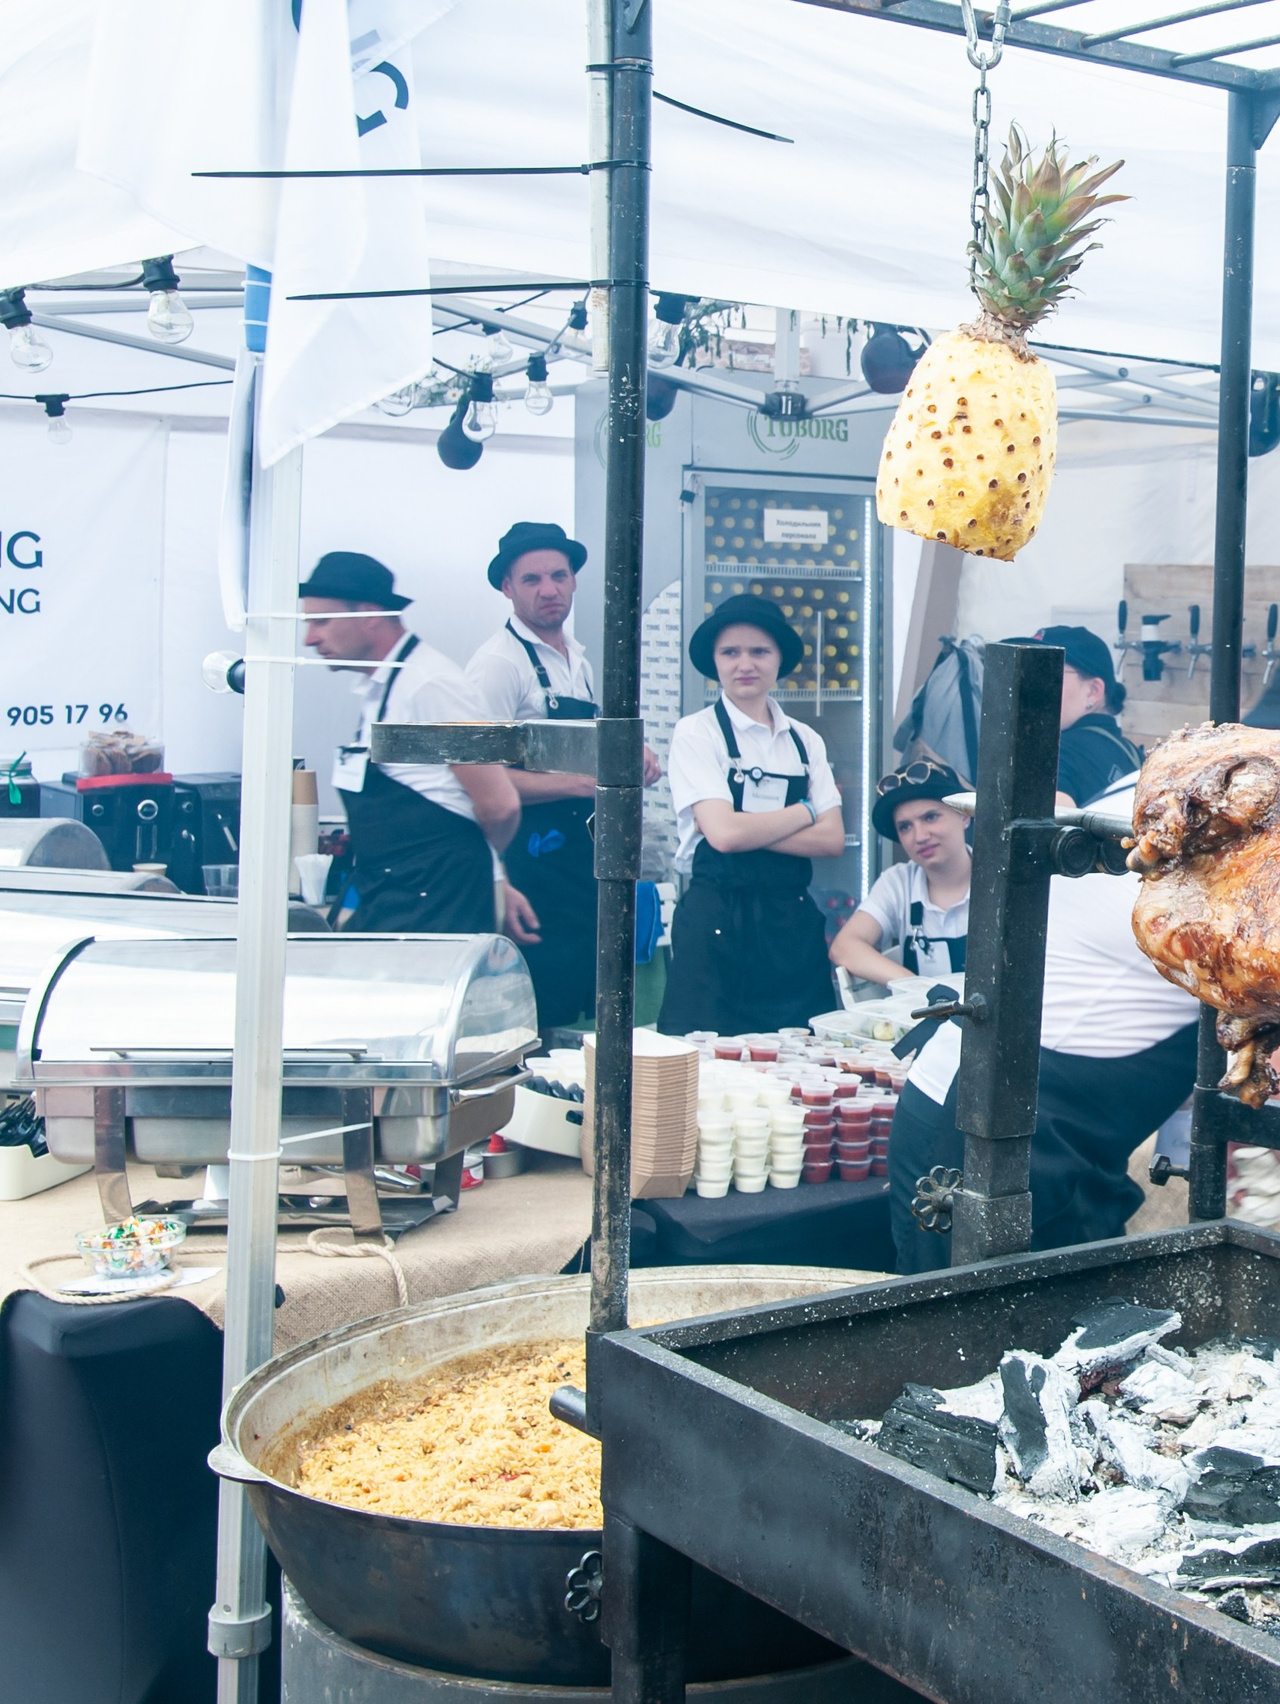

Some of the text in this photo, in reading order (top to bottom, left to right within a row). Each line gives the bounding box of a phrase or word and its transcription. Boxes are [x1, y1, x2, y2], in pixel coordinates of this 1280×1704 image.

[0, 530, 43, 570] G
[7, 703, 128, 726] 905 17 96
